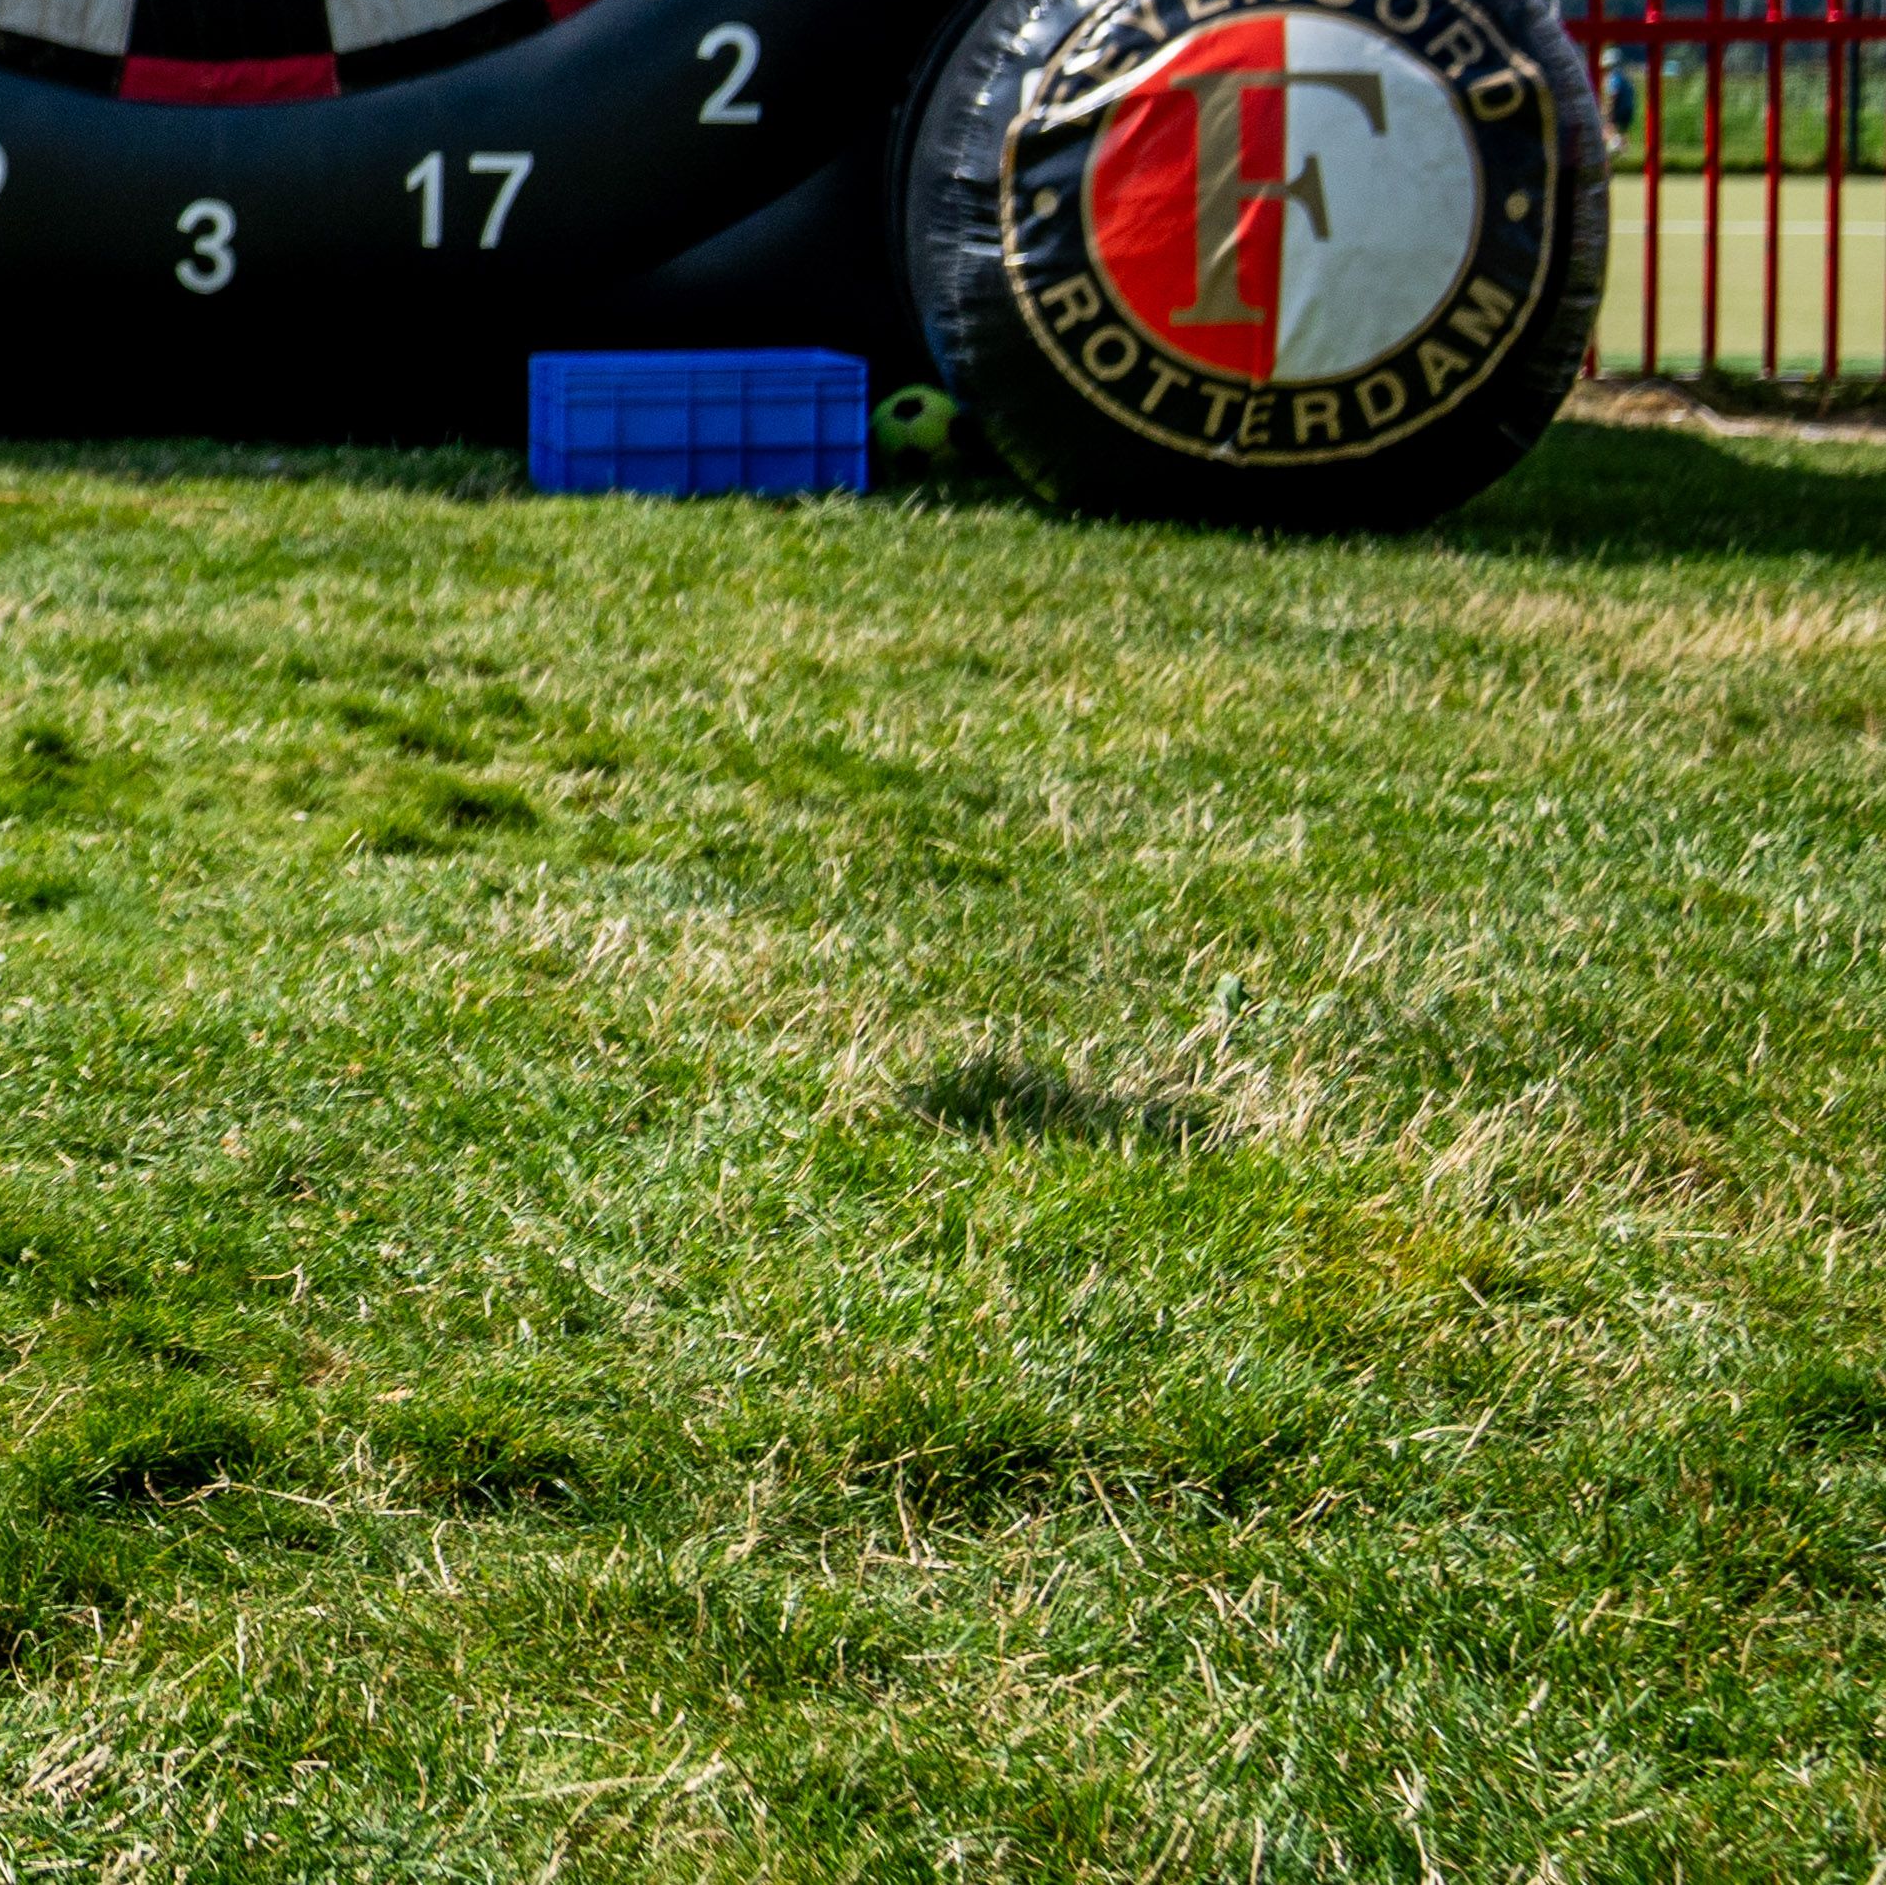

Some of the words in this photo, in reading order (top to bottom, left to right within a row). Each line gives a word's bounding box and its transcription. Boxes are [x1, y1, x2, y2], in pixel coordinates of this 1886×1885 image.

[695, 24, 759, 121] 2
[175, 197, 237, 295] 3
[404, 151, 533, 247] 17
[1169, 72, 1388, 328] F
[1040, 273, 1517, 447] ROTTERDAM
